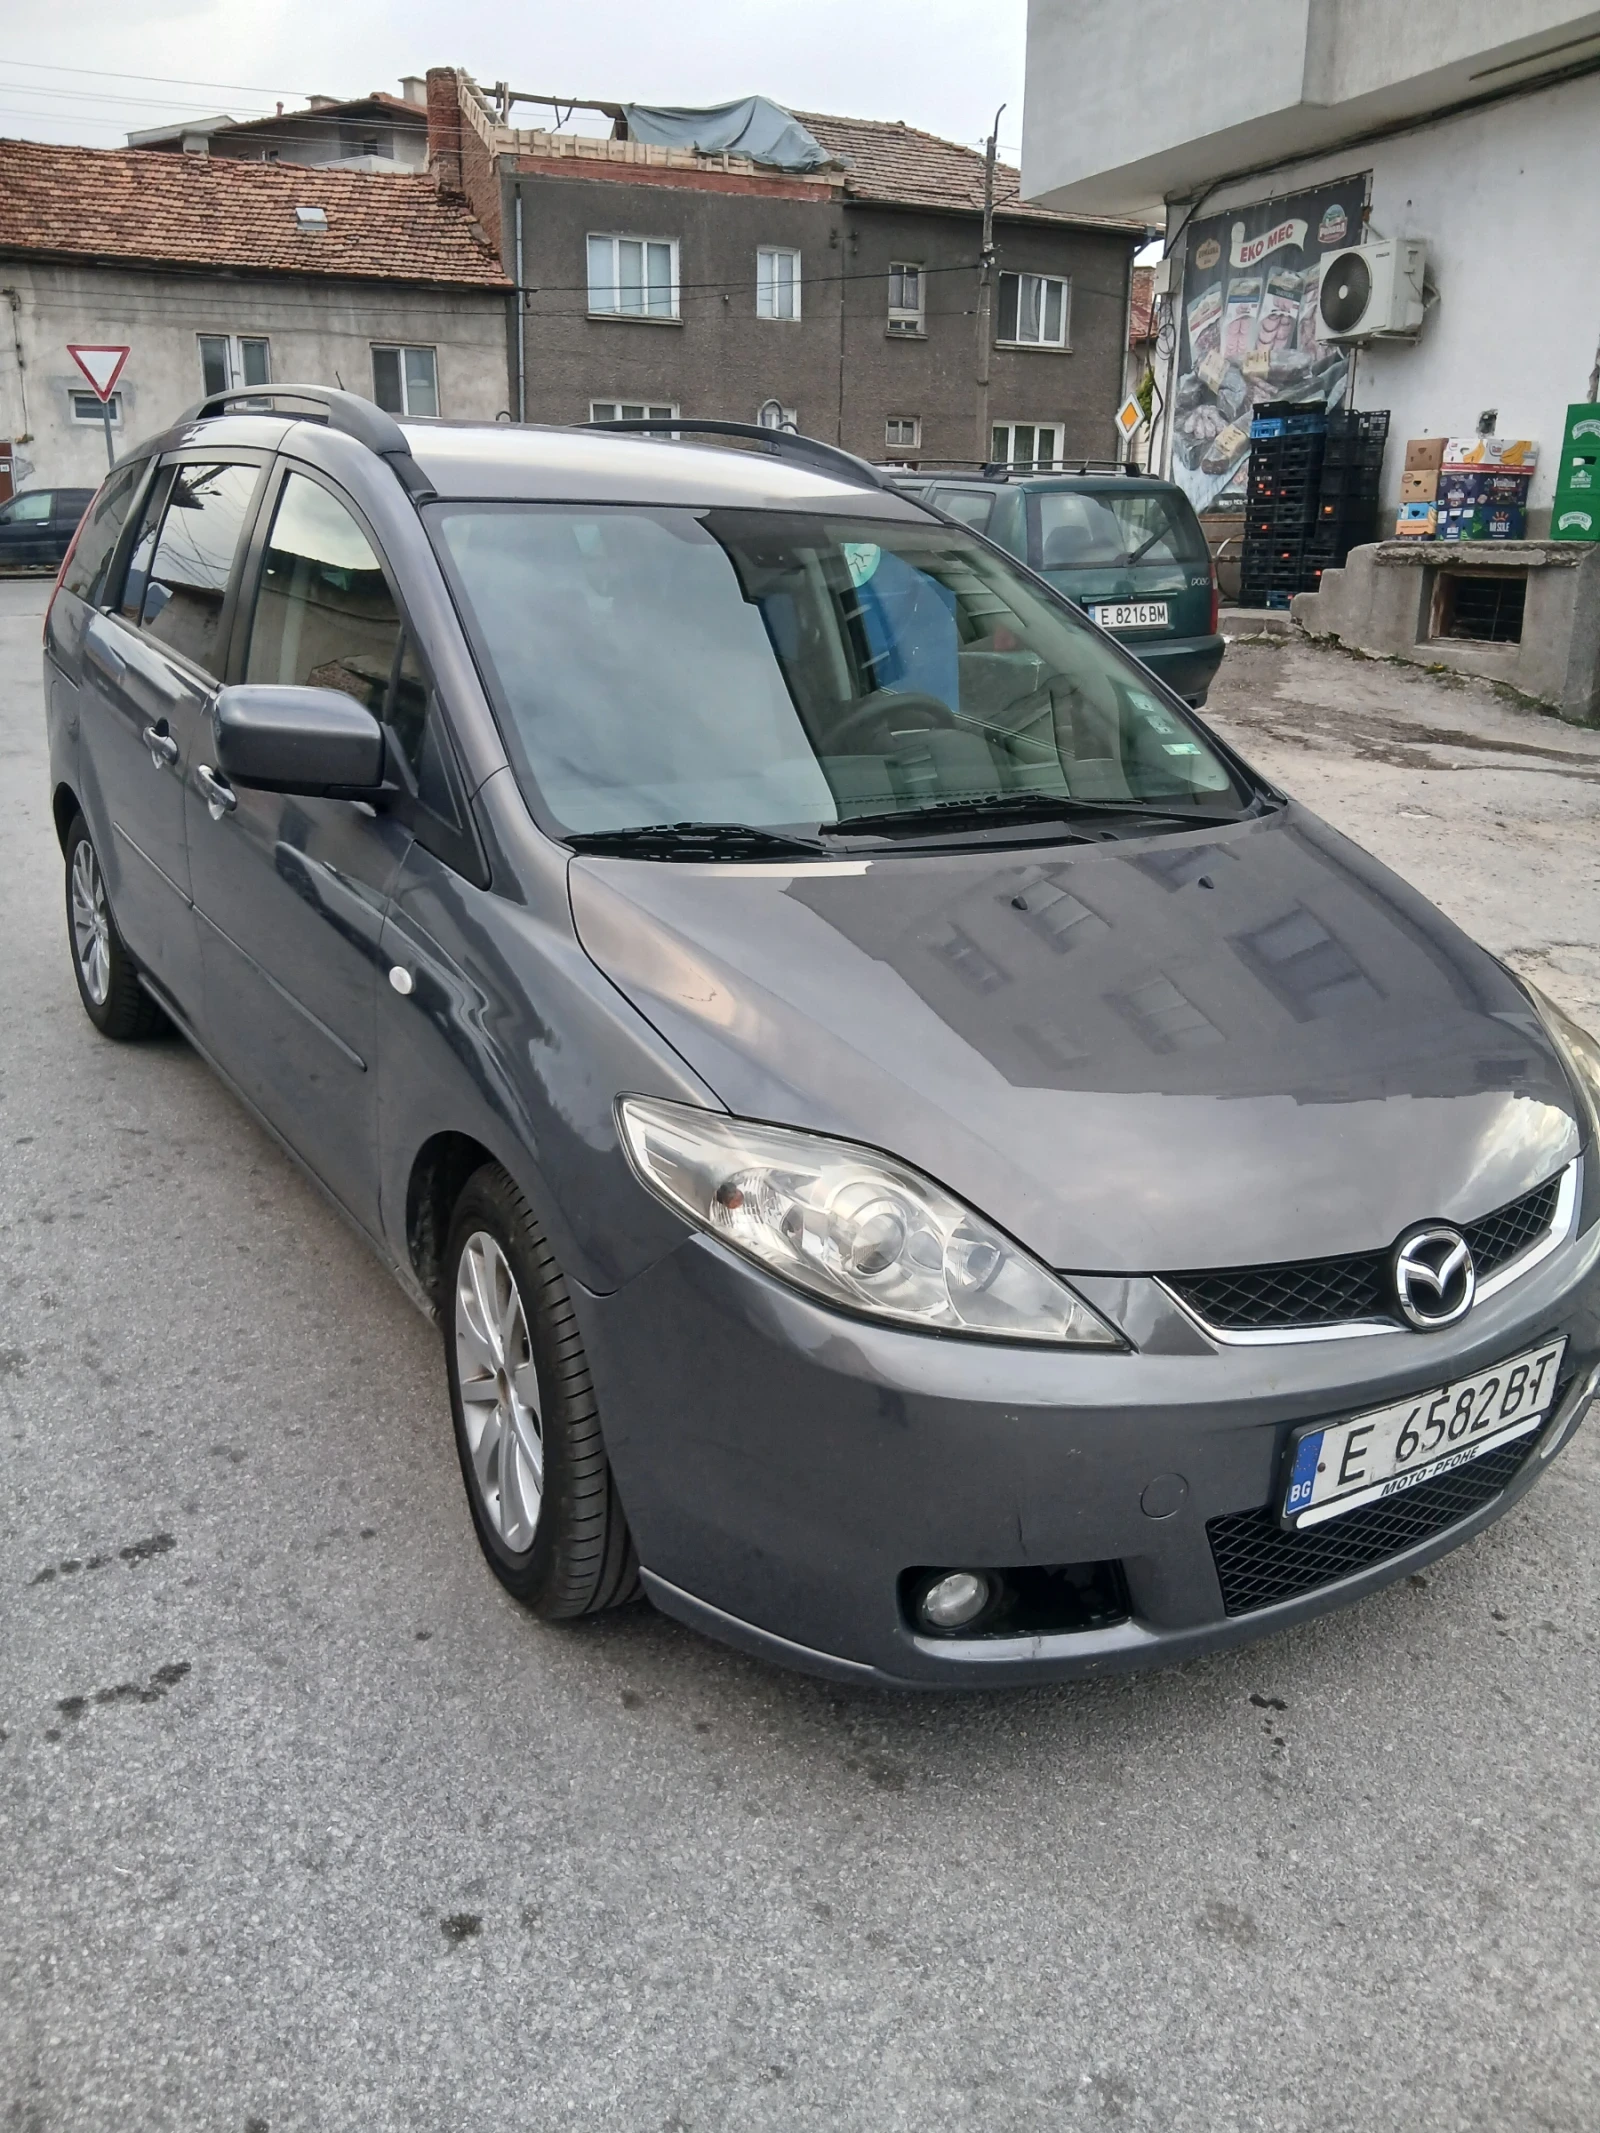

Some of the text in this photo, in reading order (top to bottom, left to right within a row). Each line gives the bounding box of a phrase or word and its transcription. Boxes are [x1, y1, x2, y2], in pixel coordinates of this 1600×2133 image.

[1239, 243, 1265, 263] ЕКО
[1267, 223, 1294, 250] МЕС
[1380, 1445, 1479, 1497] MOTO-PFOHE
[1290, 1481, 1311, 1502] BG
